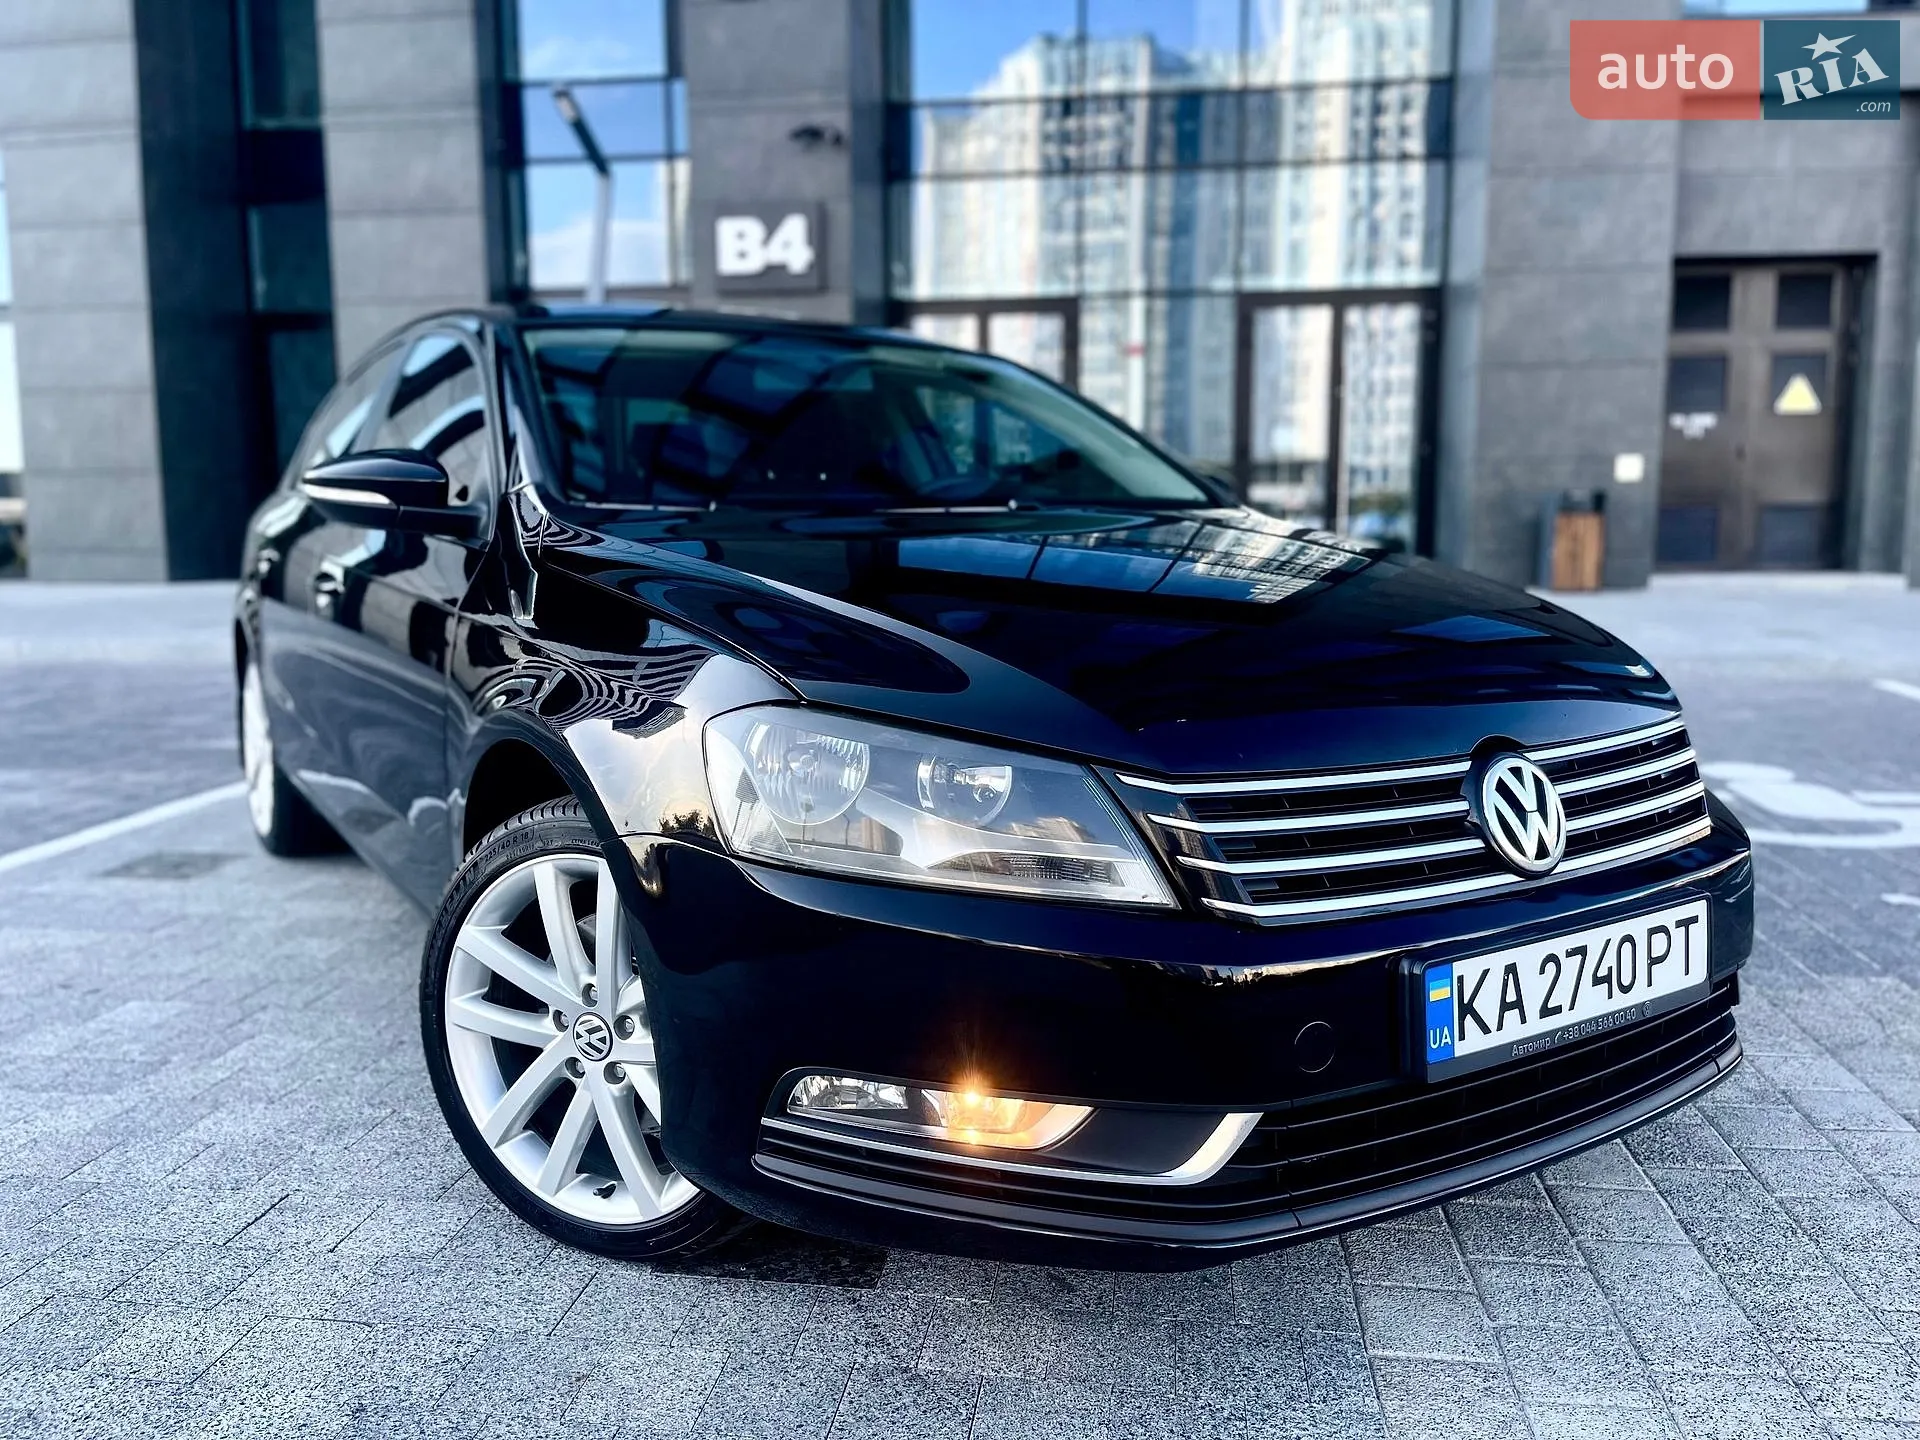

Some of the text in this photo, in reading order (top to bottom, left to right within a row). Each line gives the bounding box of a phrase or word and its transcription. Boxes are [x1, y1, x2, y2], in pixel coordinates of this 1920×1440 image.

[715, 213, 815, 277] B4
[1538, 933, 1637, 1020] 2740
[1429, 1026, 1452, 1049] UA
[1511, 1037, 1551, 1057] Автомир
[1562, 1025, 1580, 1041] +38
[1580, 1020, 1597, 1036] 044
[1614, 1012, 1626, 1025] 00
[1626, 1007, 1637, 1021] 40
